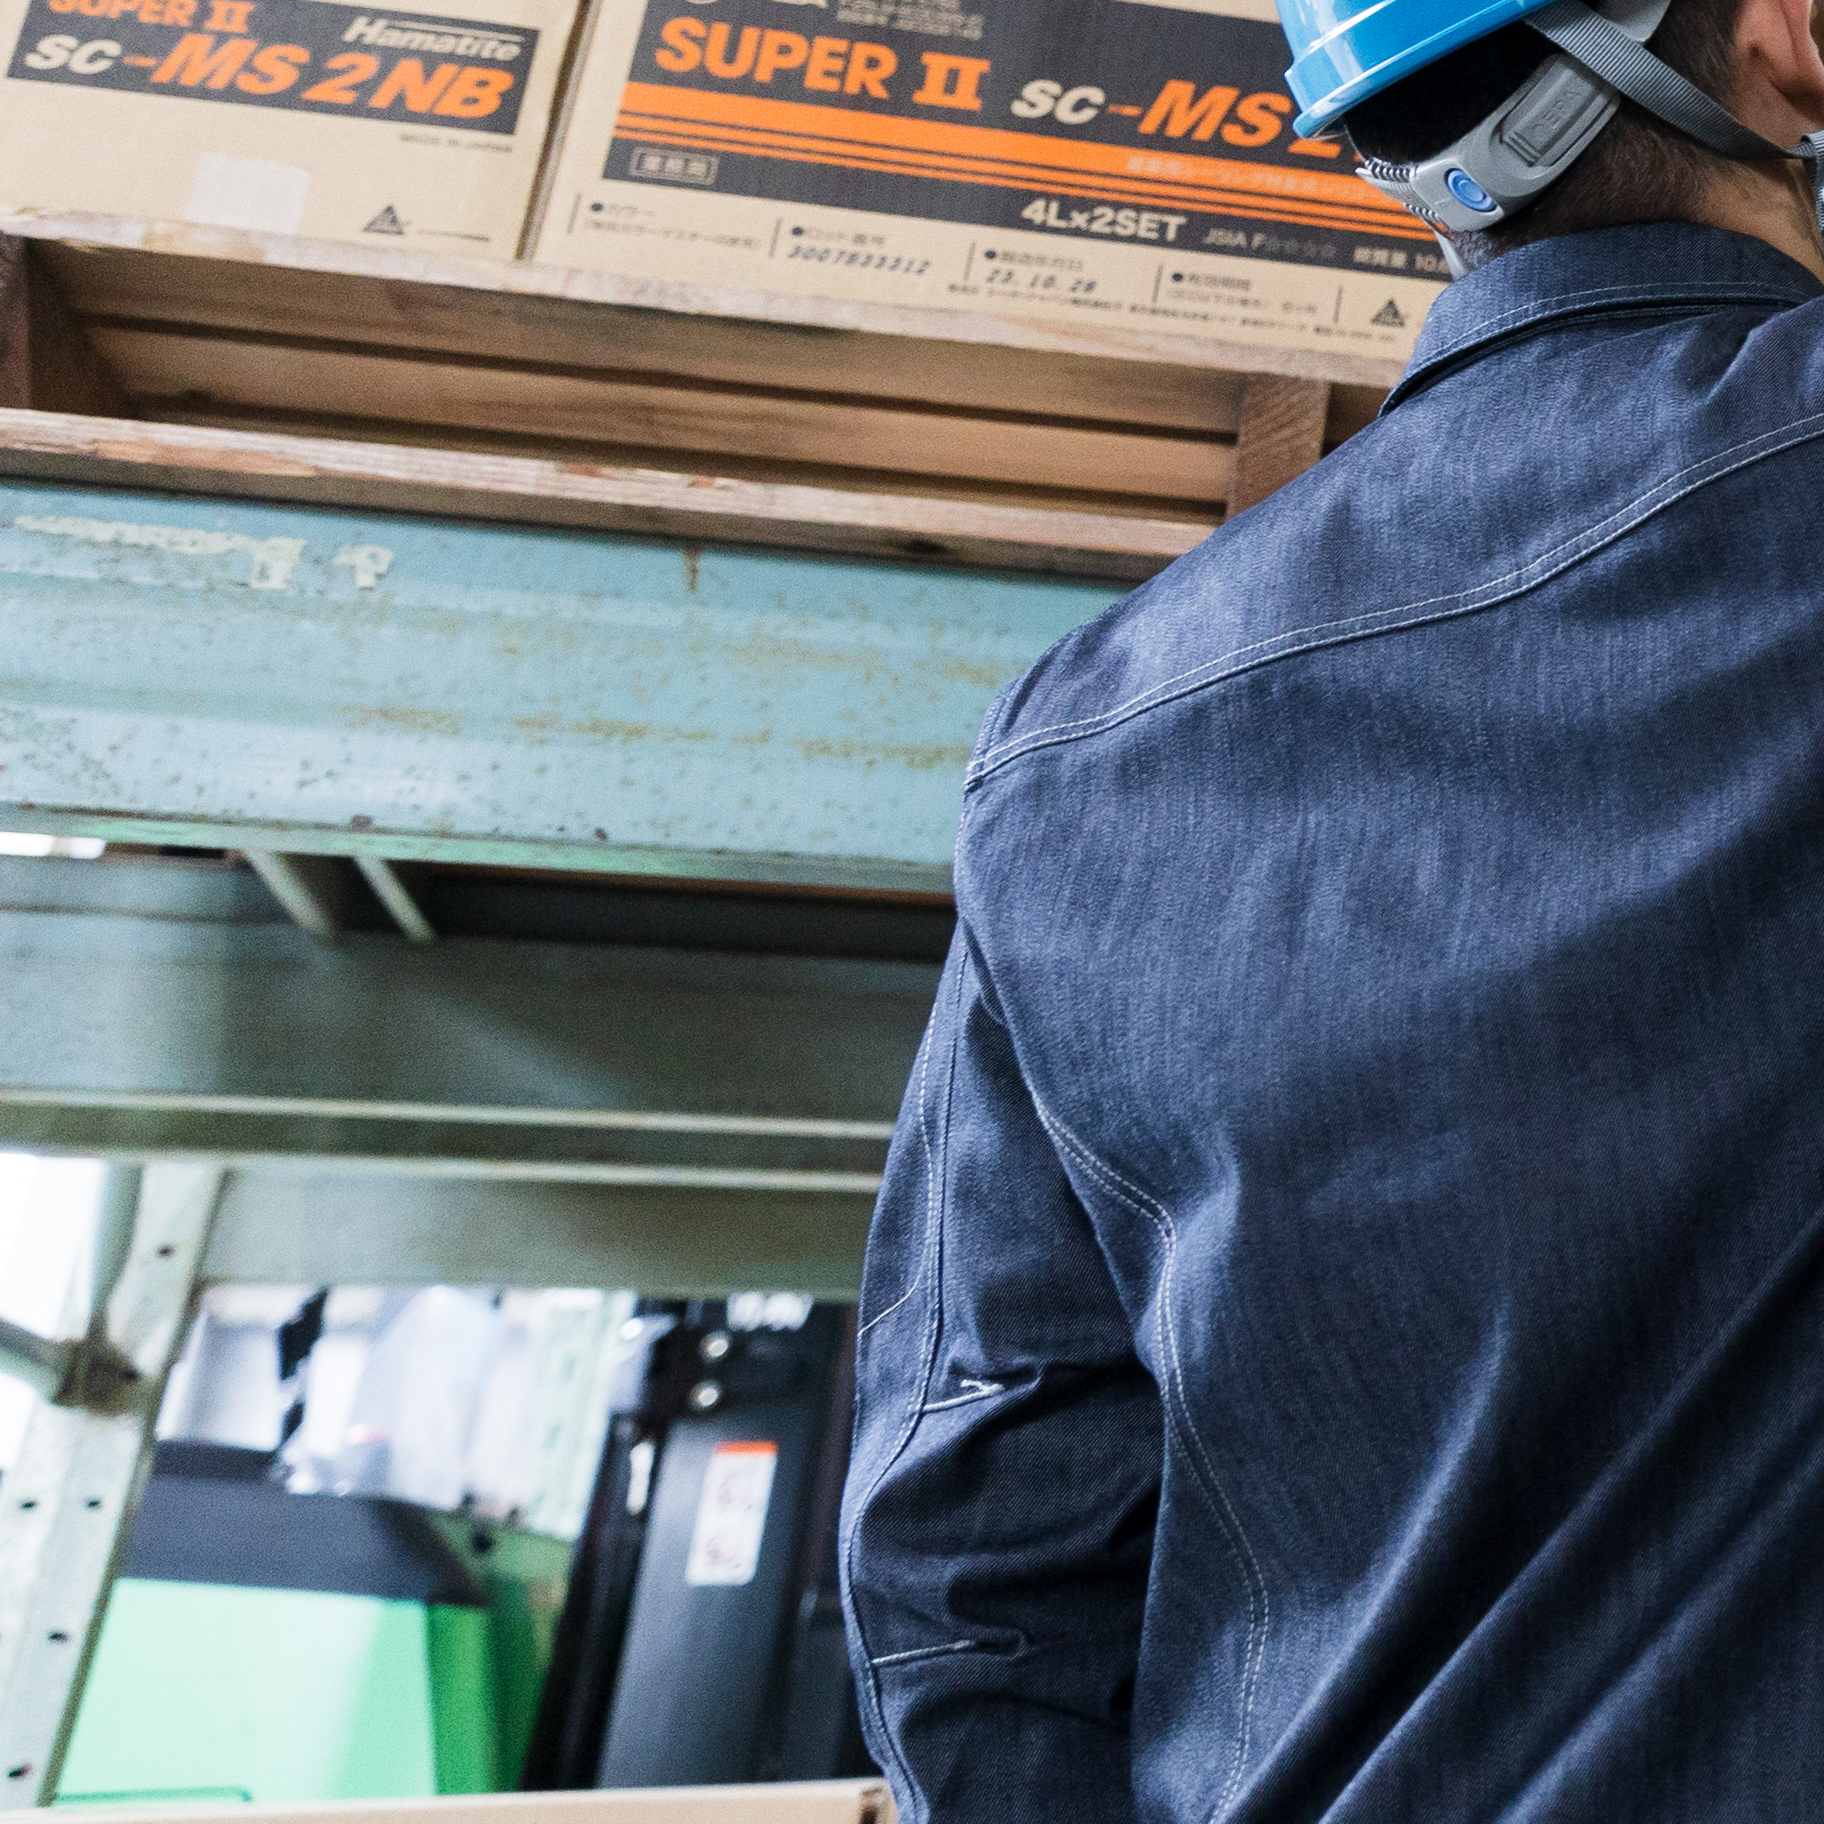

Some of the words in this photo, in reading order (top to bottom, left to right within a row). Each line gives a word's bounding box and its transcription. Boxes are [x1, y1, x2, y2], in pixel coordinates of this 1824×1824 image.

[341, 14, 524, 65] Hamatite
[655, 15, 899, 100] SUPER
[912, 52, 991, 114] II
